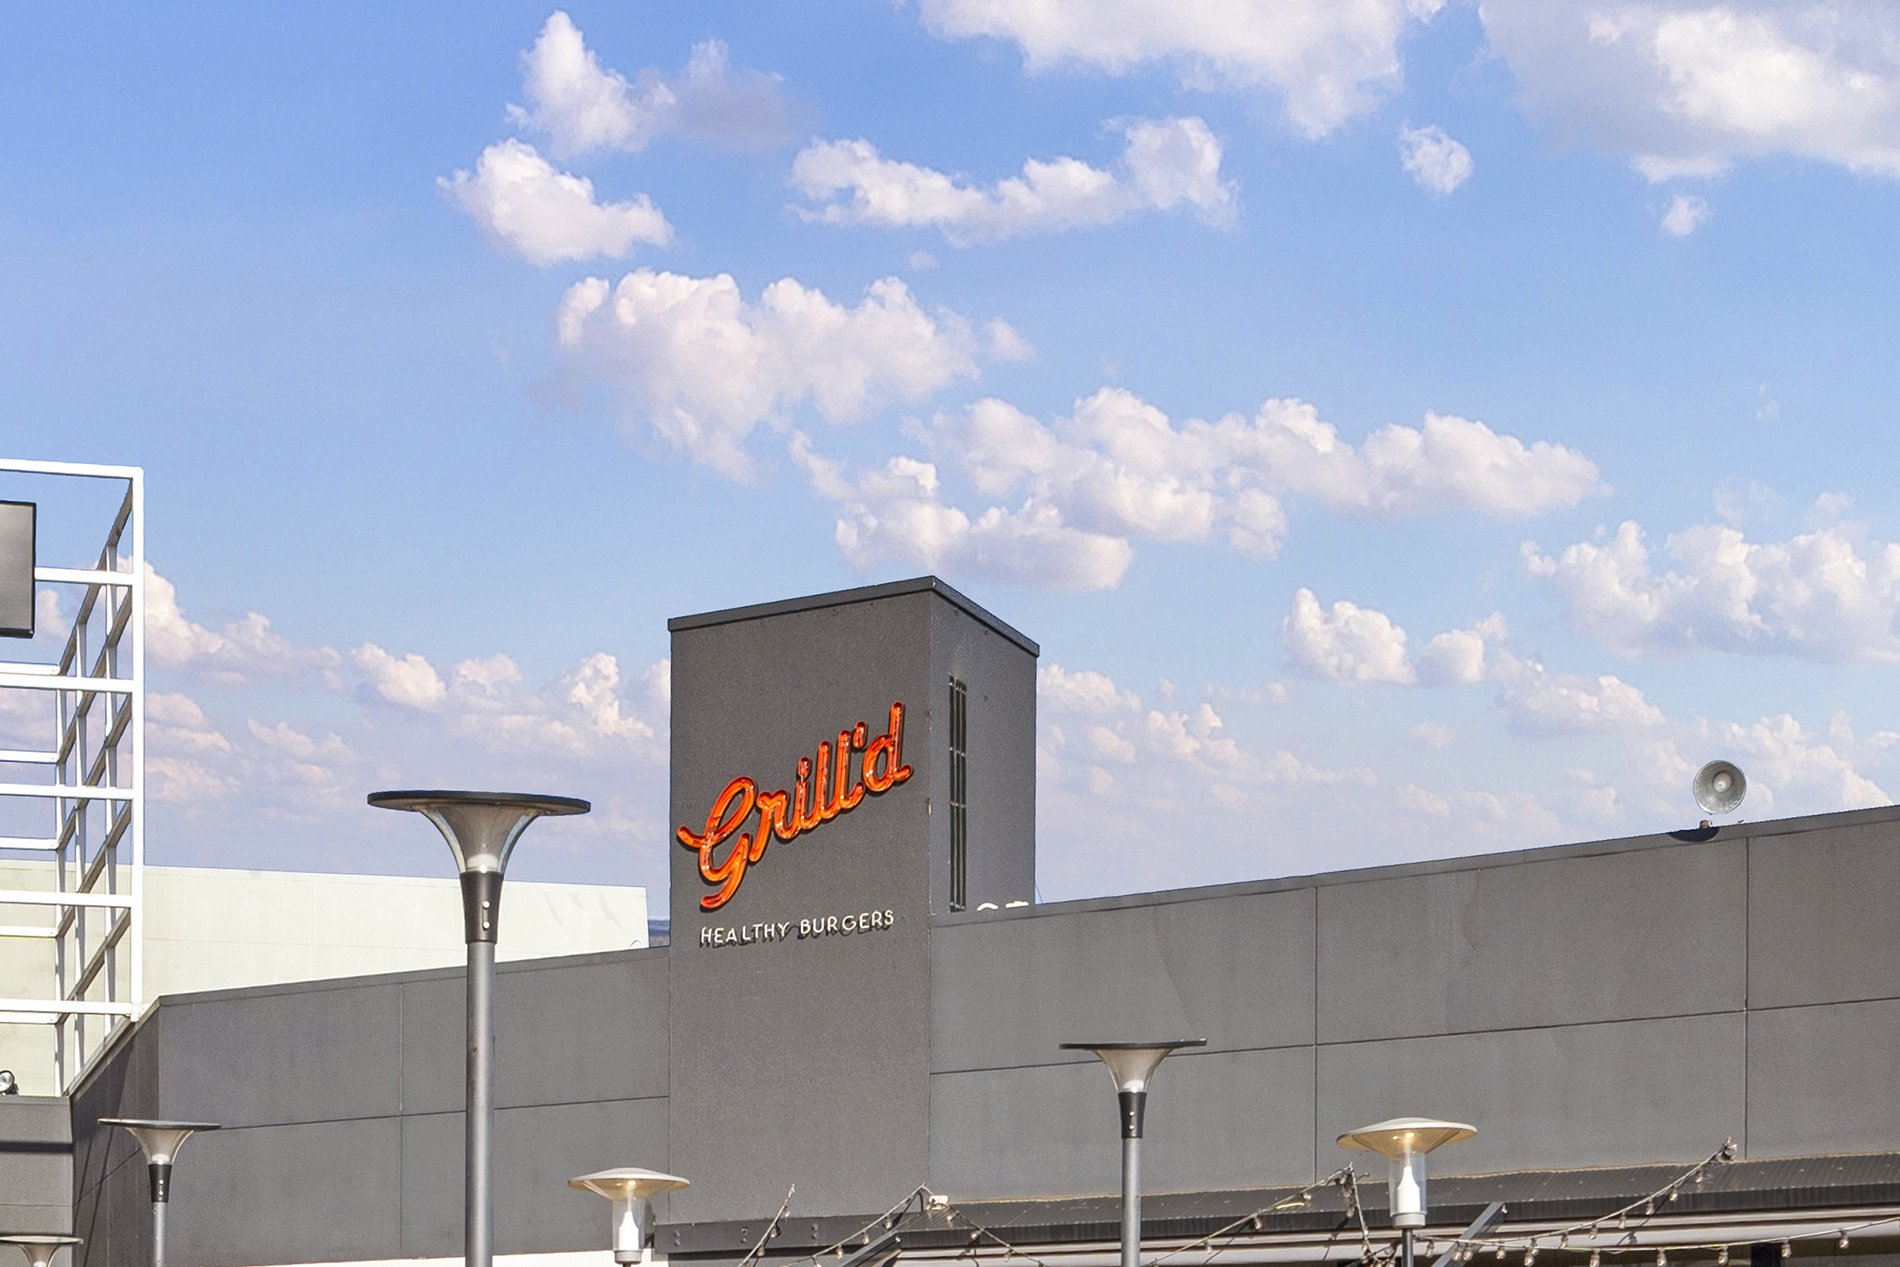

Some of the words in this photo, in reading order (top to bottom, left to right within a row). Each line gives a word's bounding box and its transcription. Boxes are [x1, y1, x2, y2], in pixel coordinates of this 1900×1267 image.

[677, 702, 913, 911] Grill'd
[701, 921, 790, 944] HEALTHY
[800, 910, 895, 934] BURGERS
